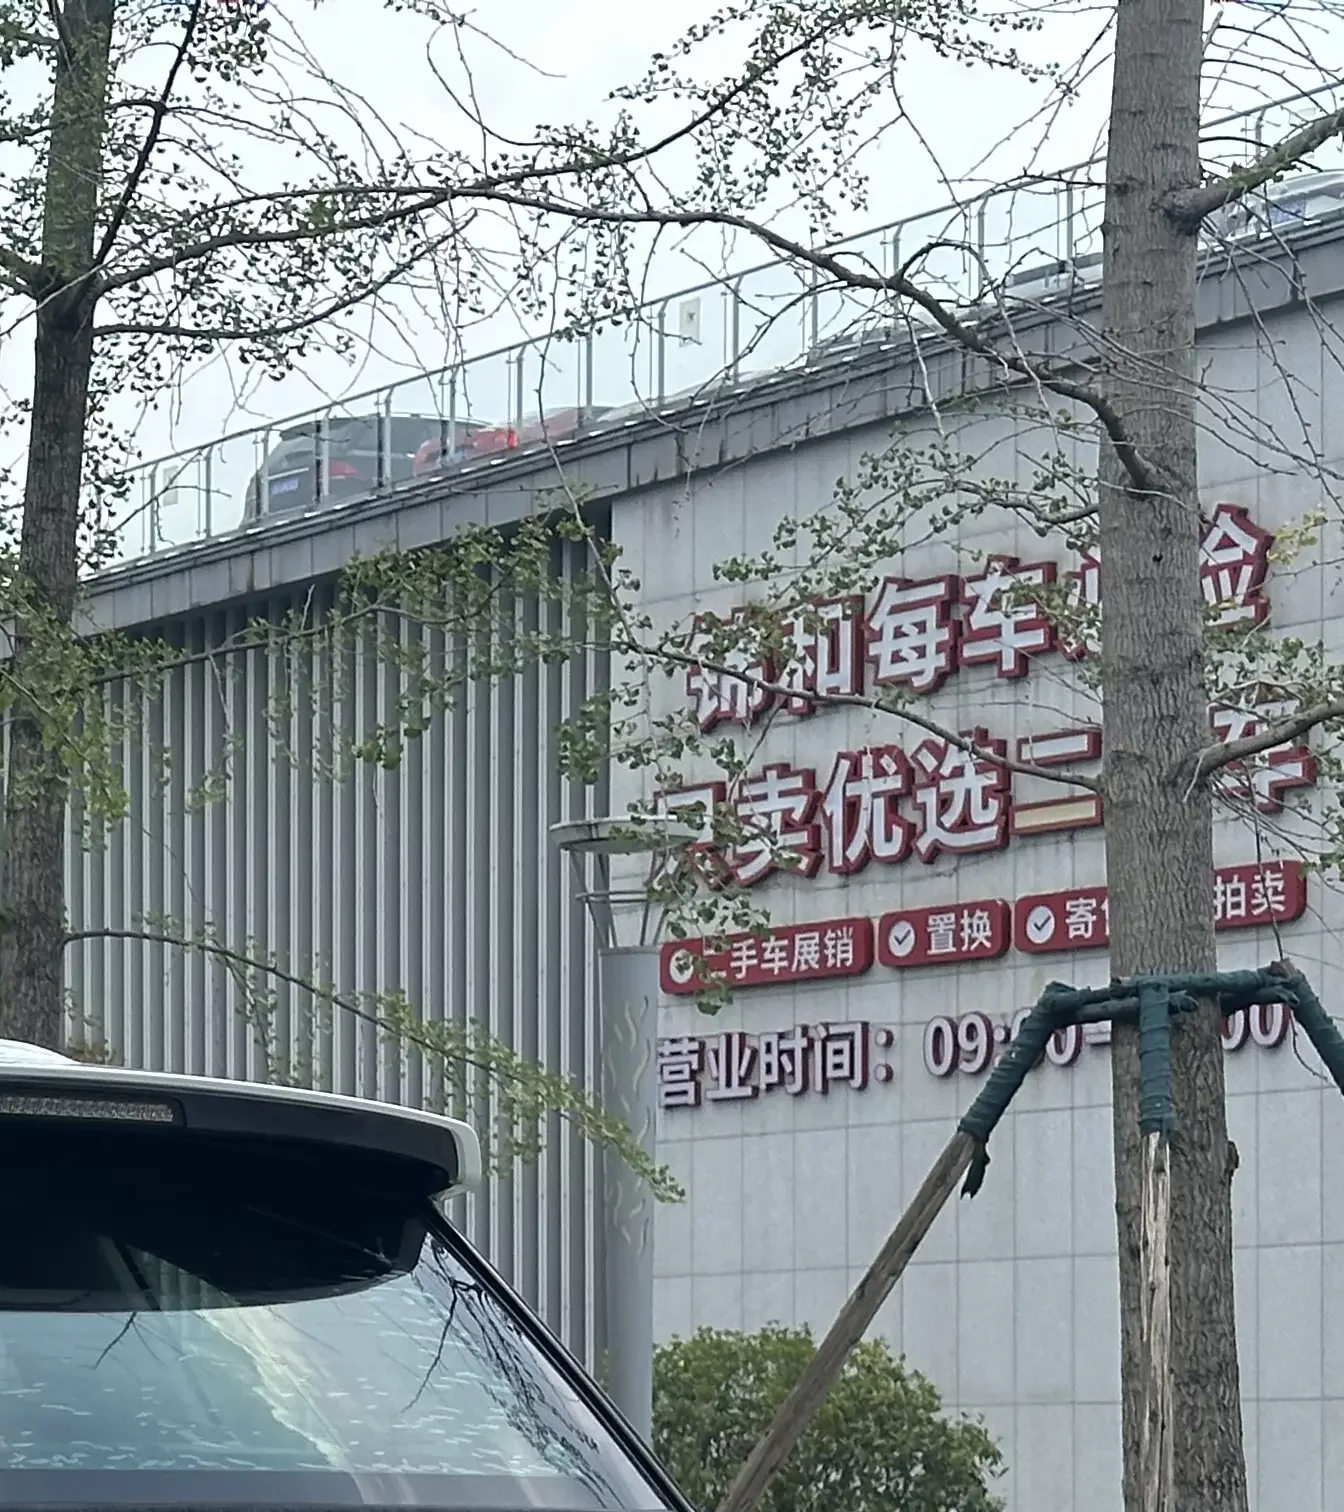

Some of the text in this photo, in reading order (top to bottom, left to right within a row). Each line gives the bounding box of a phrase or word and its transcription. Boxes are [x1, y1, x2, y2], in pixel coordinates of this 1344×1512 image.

[686, 503, 1274, 733] 和每车
[655, 700, 1318, 890] 只卖优选二车
[926, 907, 992, 955] 置换
[1213, 870, 1286, 920] 拍卖
